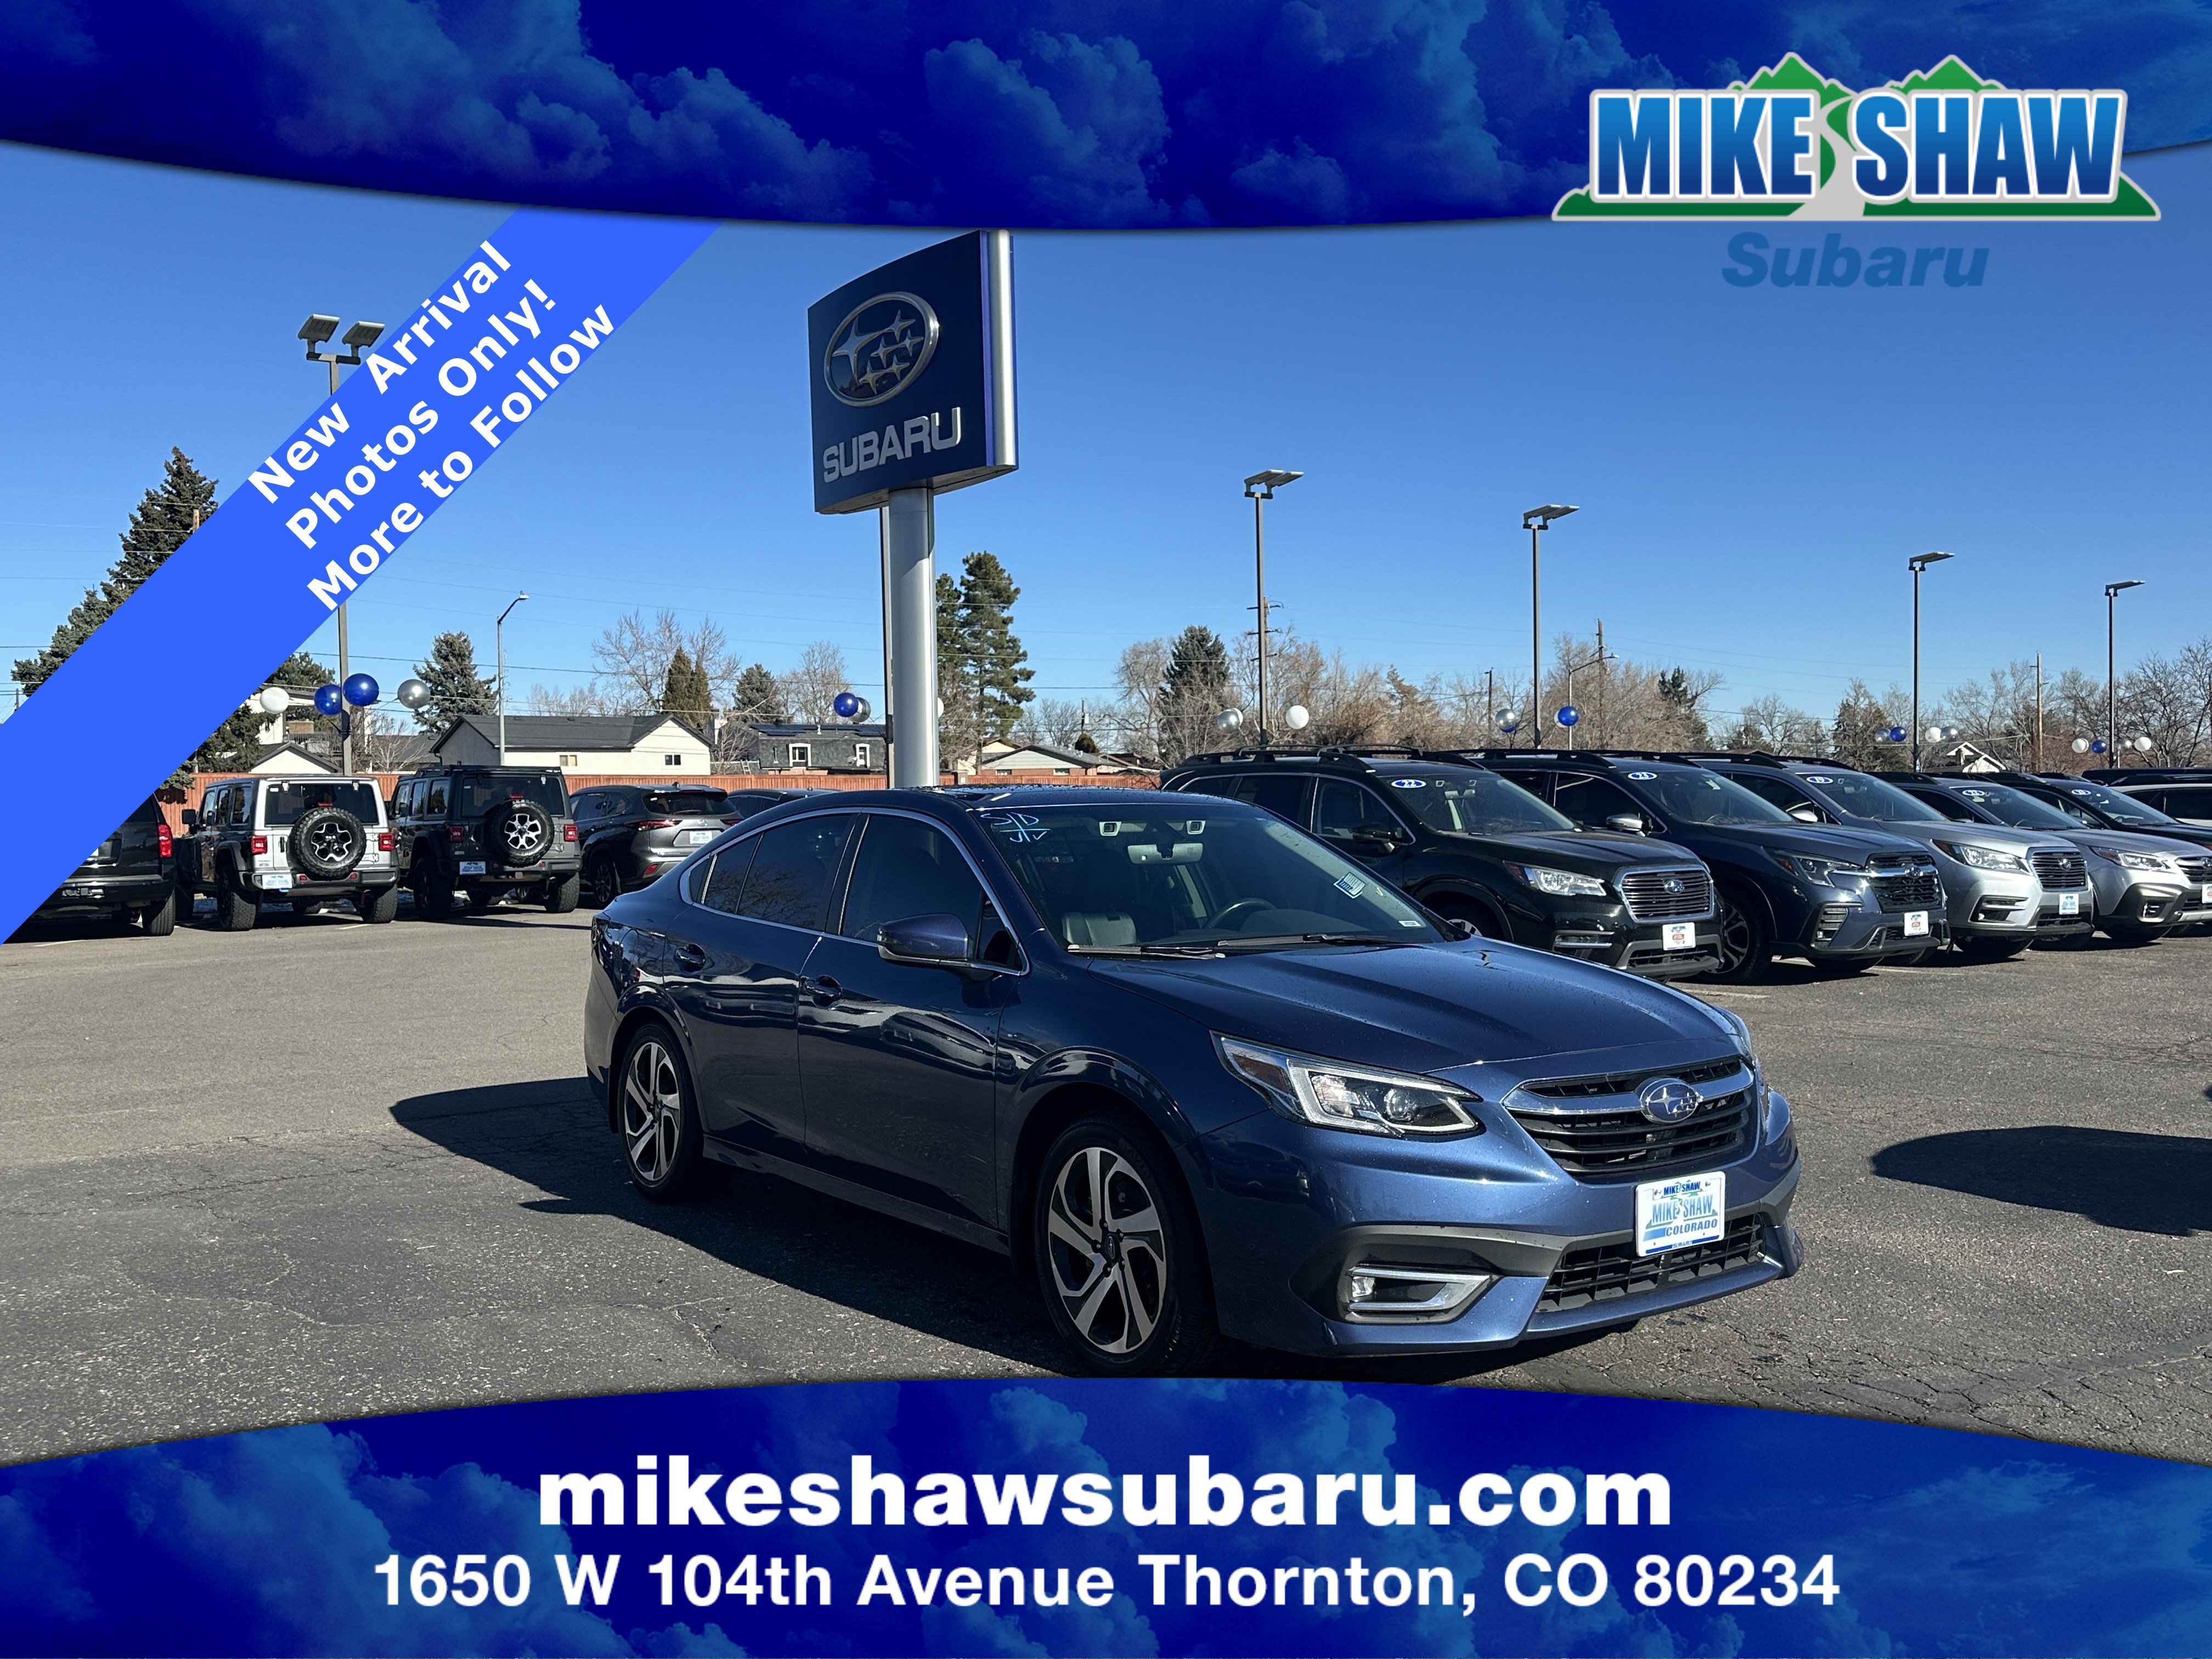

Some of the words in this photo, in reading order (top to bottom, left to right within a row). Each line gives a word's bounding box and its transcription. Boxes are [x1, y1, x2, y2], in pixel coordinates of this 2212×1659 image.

[823, 407, 961, 483] SUBARU
[1664, 1185, 1679, 1195] MIKE
[1682, 1181, 1701, 1192] SHAW
[1652, 1200, 1678, 1224] MIKE
[1683, 1194, 1713, 1218] SHAW
[1666, 1218, 1718, 1237] COLORADO
